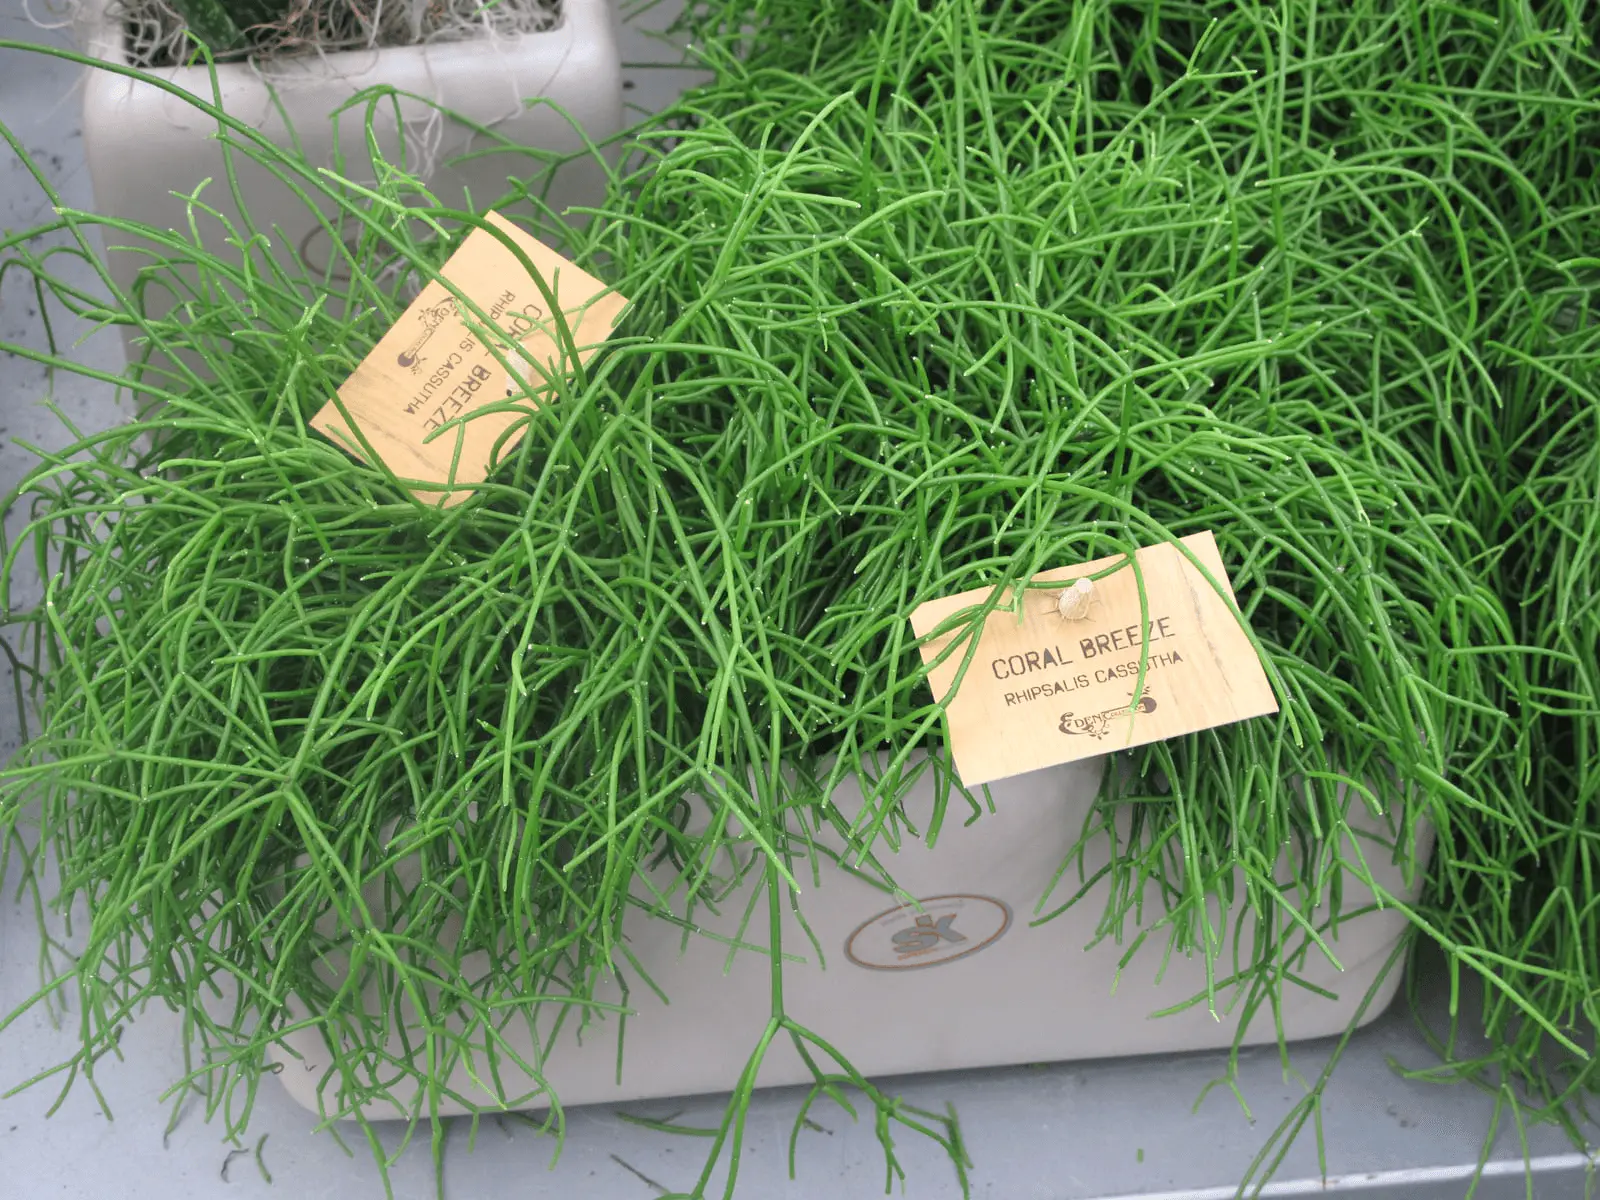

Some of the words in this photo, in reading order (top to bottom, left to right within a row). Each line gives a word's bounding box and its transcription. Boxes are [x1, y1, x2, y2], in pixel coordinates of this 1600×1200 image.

[459, 289, 516, 352] RHIPIS
[402, 352, 463, 415] CASSUTHA
[423, 364, 492, 430] BREEZE
[991, 645, 1074, 680] CORAL
[1079, 616, 1176, 659] BREEZE
[1003, 674, 1090, 707] RHIPSALIS
